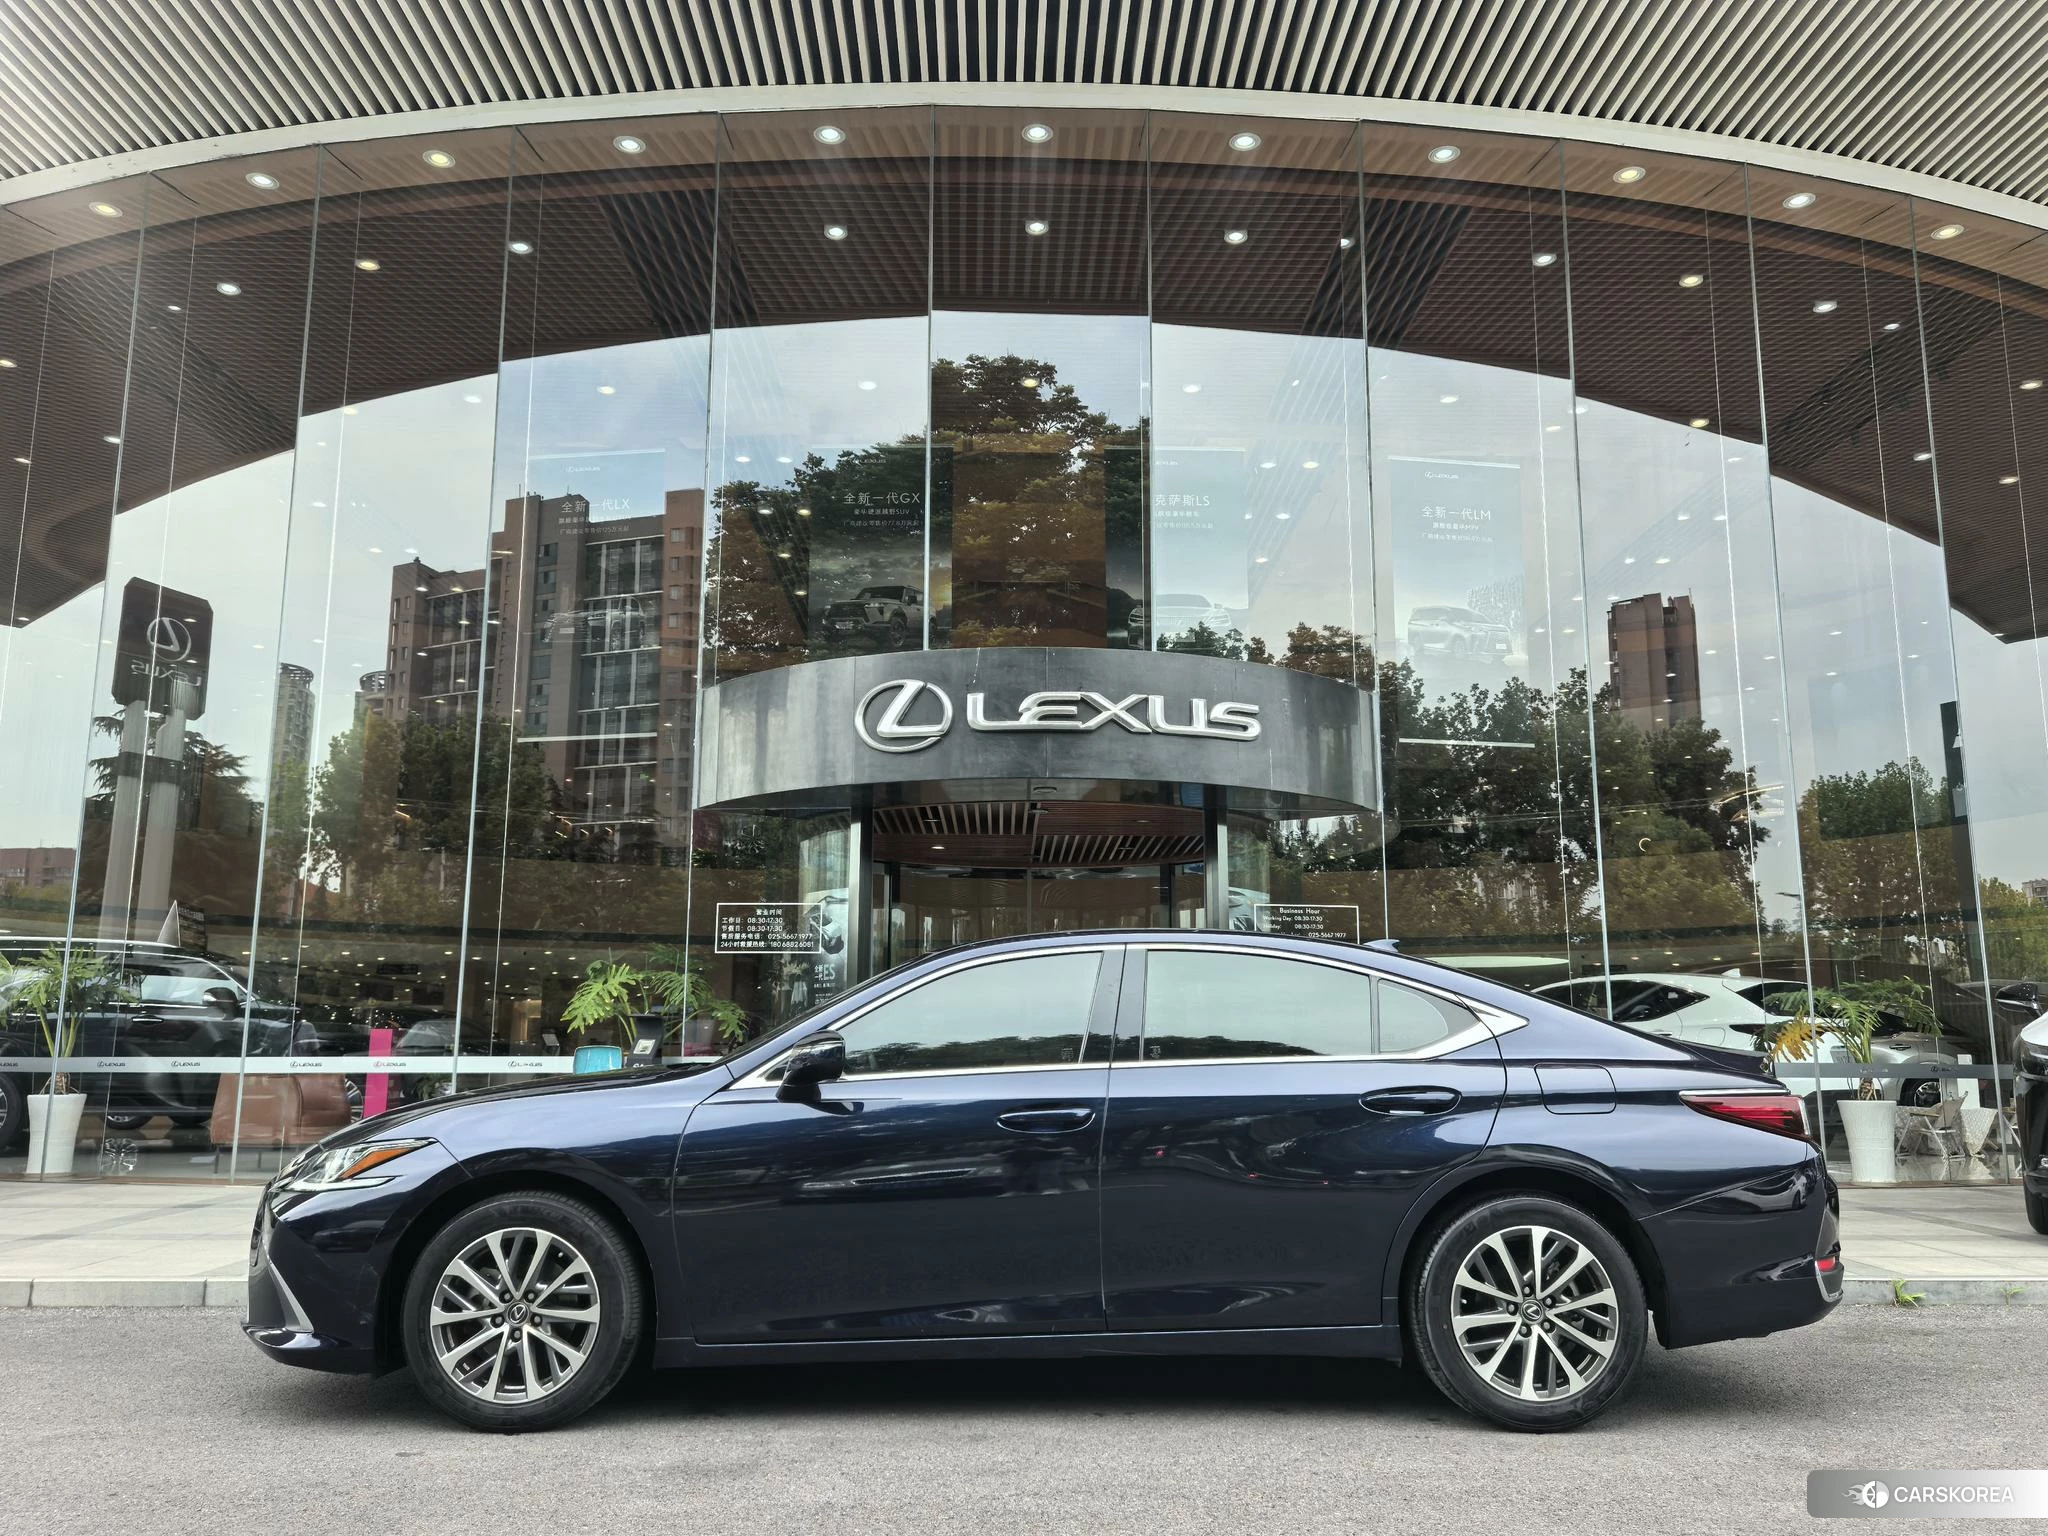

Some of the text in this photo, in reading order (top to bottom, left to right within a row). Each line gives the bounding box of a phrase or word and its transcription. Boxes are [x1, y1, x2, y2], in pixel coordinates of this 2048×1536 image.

[561, 497, 630, 513] 全新一代LX
[843, 492, 920, 506] 全新一代GX
[1422, 506, 1491, 521] 全新一代LM
[967, 691, 1262, 741] LEXUS
[823, 964, 836, 981] ES
